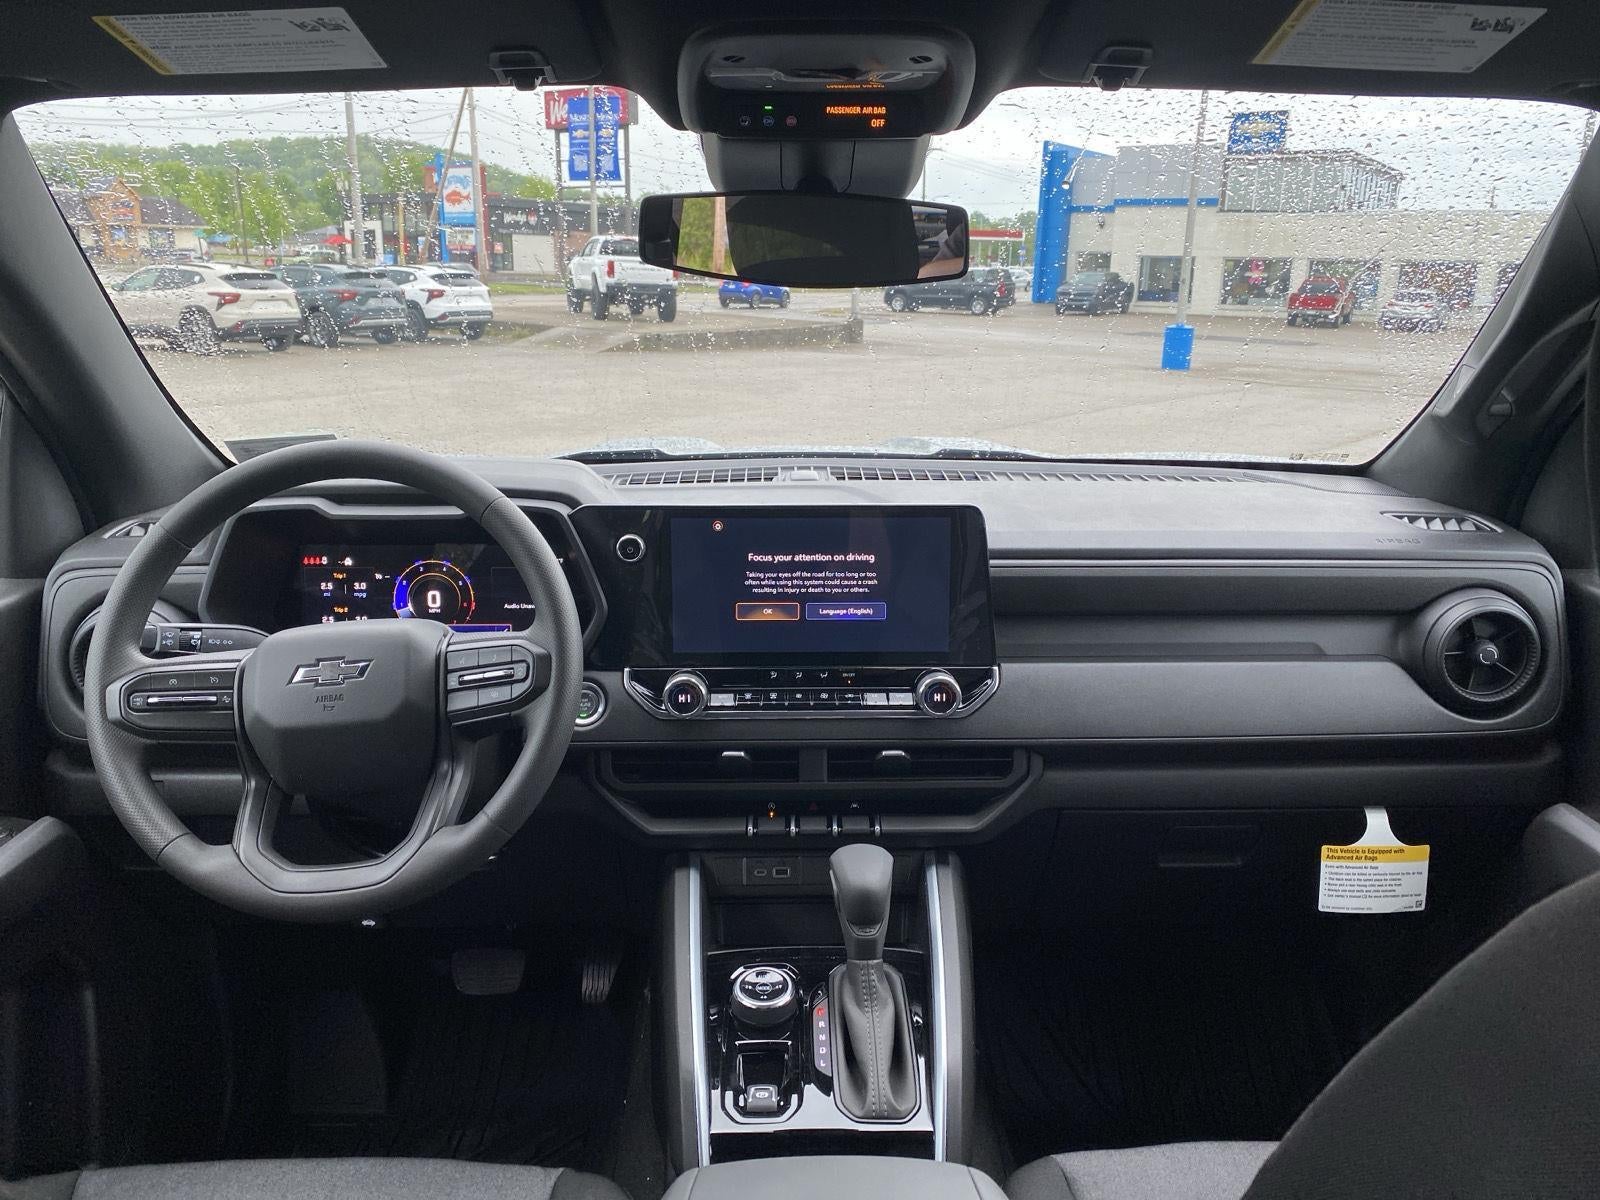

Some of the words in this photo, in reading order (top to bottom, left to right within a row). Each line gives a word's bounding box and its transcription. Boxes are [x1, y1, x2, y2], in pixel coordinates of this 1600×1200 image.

[826, 106, 861, 114] PASSENGER
[862, 106, 873, 114] AIR
[874, 106, 886, 114] BAG
[871, 118, 885, 127] OFF
[748, 552, 773, 562] Focus
[773, 554, 793, 564] your
[793, 553, 832, 562] attention
[846, 552, 875, 564] driving
[745, 571, 765, 579] Taking
[792, 570, 802, 578] off
[845, 571, 859, 579] long
[320, 582, 333, 590] 2.5
[353, 582, 367, 590] 3.0
[744, 578, 760, 586] often
[776, 579, 792, 587] using
[804, 579, 824, 587] system
[752, 587, 777, 595] resulting
[784, 587, 800, 595] injury
[427, 590, 441, 608] 0
[819, 608, 847, 616] Language
[847, 608, 874, 616] (English)
[321, 616, 335, 624] 2.5
[313, 693, 345, 704] AIRBAG
[678, 693, 691, 704] HI
[933, 692, 946, 703] HI
[1367, 848, 1393, 856] Equipped
[818, 1020, 826, 1028] R
[820, 1046, 827, 1054] D
[820, 1059, 826, 1067] L
